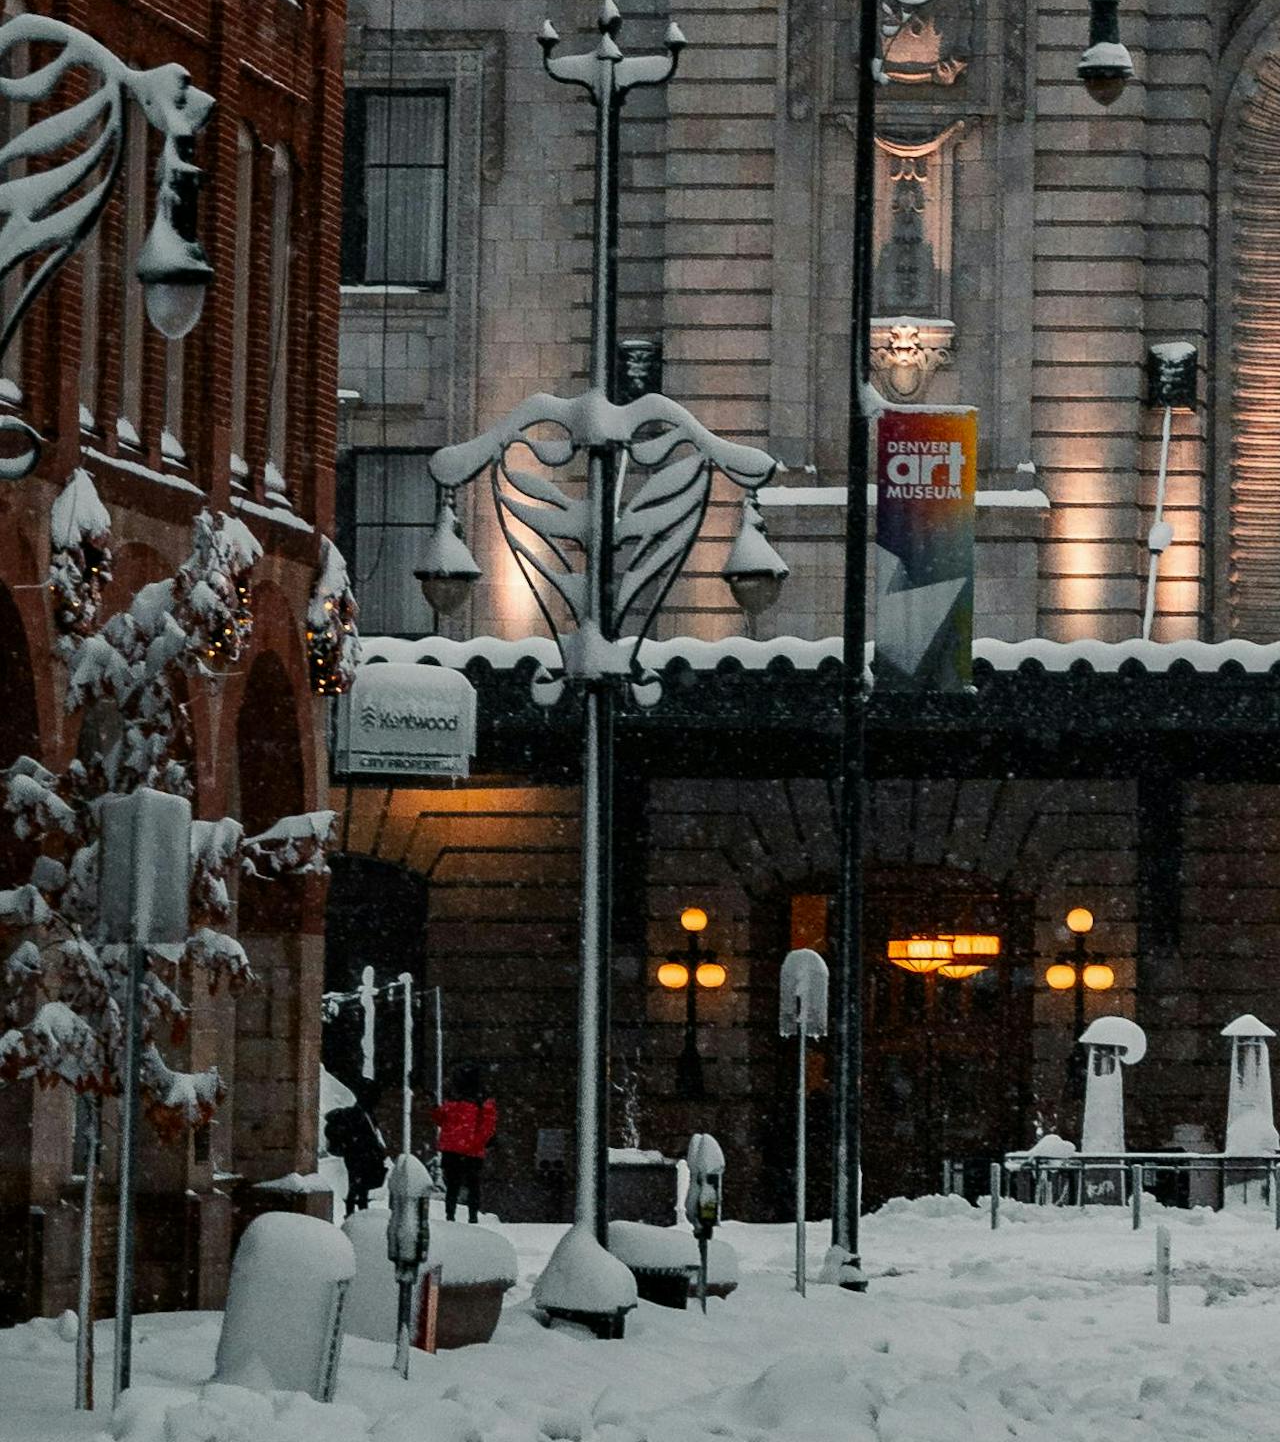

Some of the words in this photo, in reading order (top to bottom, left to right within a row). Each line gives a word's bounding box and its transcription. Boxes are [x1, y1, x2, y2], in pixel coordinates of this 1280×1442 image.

[887, 441, 950, 454] DENVER
[887, 441, 966, 485] art
[886, 485, 962, 500] MUSEUM
[379, 712, 458, 732] Kentwood
